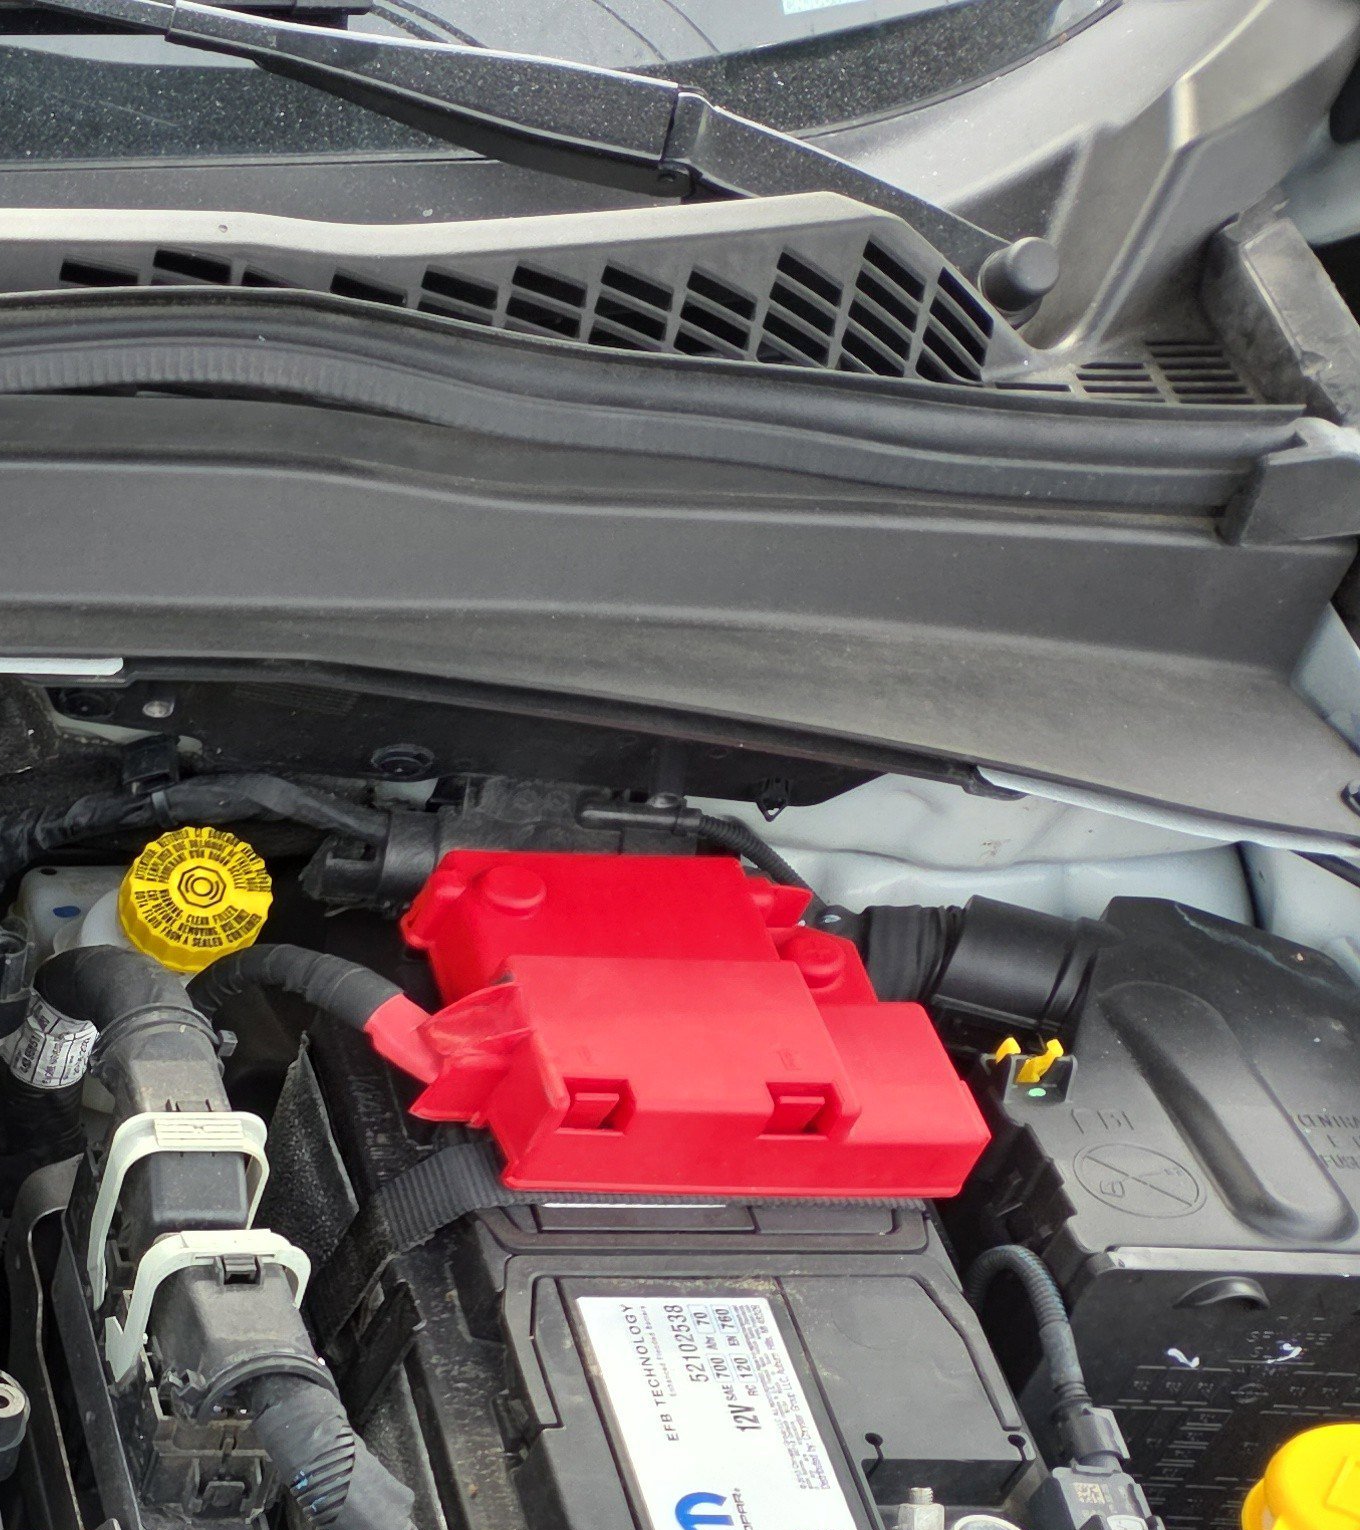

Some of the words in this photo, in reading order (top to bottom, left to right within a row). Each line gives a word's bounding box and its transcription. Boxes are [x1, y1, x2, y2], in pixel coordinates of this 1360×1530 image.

[692, 1311, 711, 1325] 70
[714, 1308, 735, 1329] 760
[619, 1303, 667, 1406] TECHNOLOGY
[662, 1304, 710, 1382] 52102538
[709, 1357, 731, 1378] 700
[732, 1357, 754, 1378] 120
[659, 1413, 679, 1441] EFB
[726, 1403, 763, 1431] 12V
